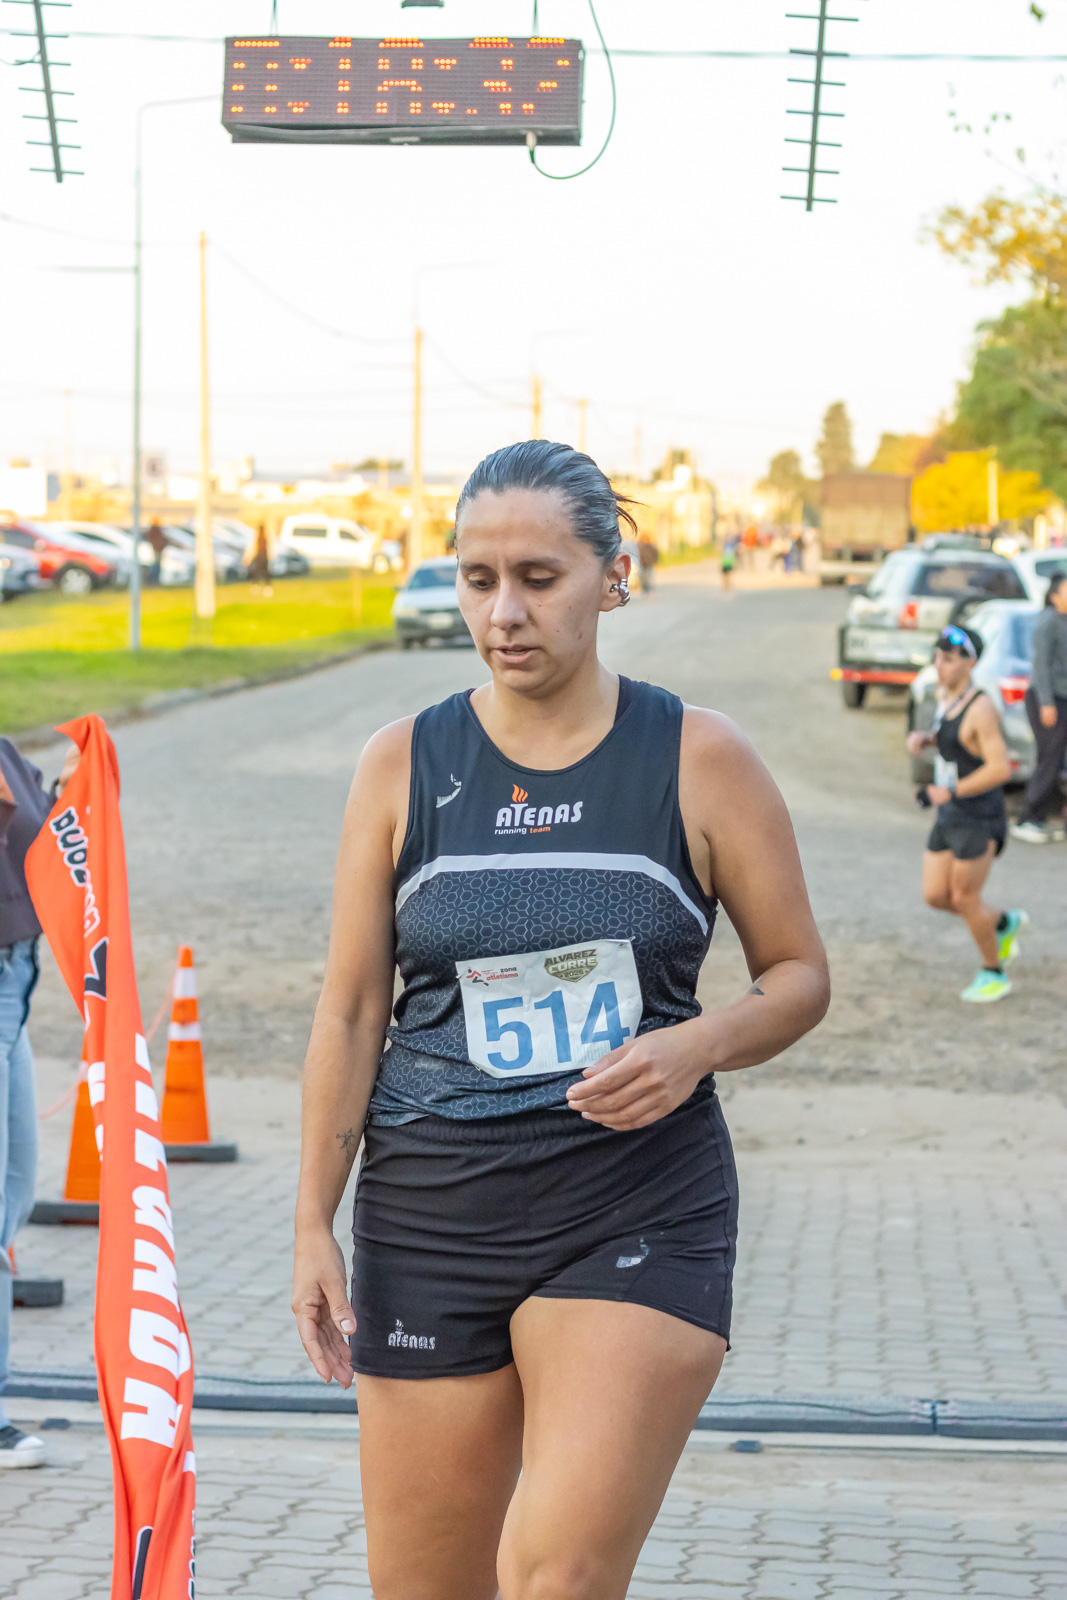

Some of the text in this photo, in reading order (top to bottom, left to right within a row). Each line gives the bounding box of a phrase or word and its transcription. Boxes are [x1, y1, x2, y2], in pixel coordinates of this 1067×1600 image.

[495, 801, 583, 827] ATENAS
[494, 826, 551, 835] running team
[544, 949, 597, 967] ALVAREZ
[548, 957, 599, 973] CORRE
[486, 972, 519, 981] atletismo
[482, 981, 631, 1071] 514
[388, 1331, 436, 1350] ATENAS
